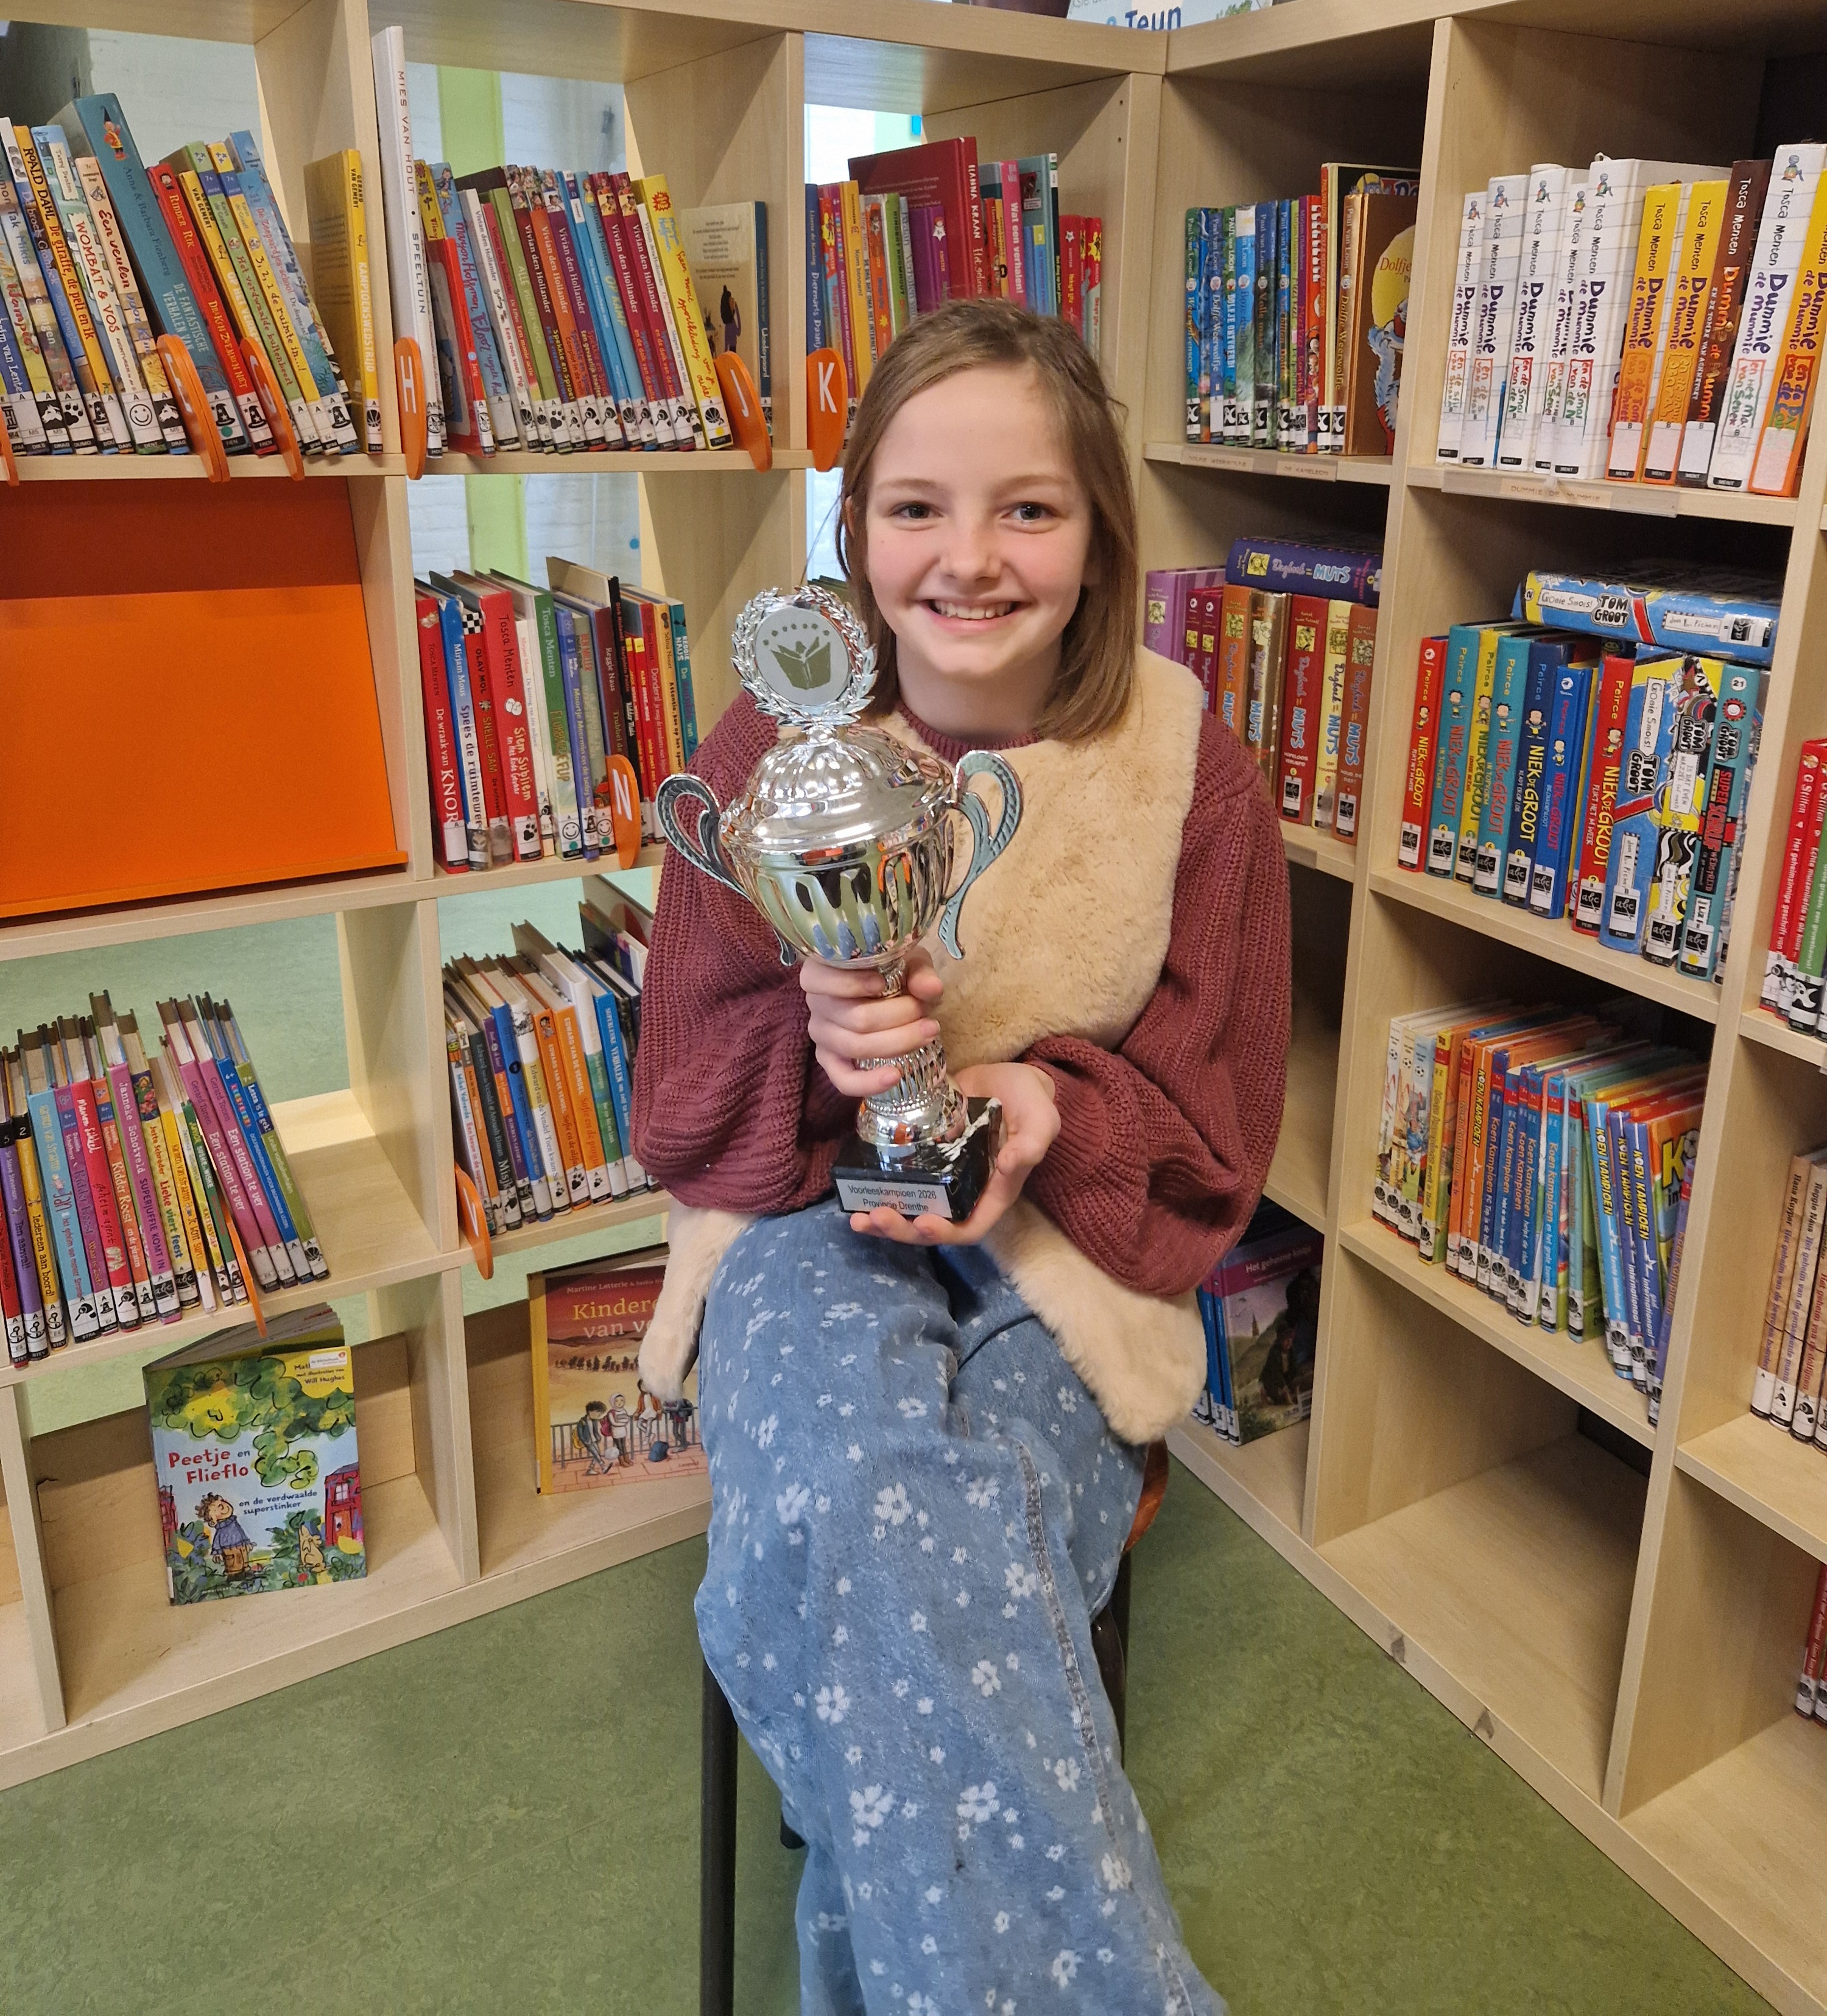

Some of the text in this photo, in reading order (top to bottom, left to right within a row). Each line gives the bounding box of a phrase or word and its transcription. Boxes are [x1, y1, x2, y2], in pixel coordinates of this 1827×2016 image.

[1125, 6, 1181, 30] Teun
[398, 71, 415, 194] MIES VAN HOUT
[23, 148, 52, 220] ROALD DAHL
[169, 194, 195, 248] RIDDER RIK
[971, 205, 980, 239] KRAAN
[1589, 202, 1606, 274] Tosca Menten
[1728, 178, 1751, 255] Tosca Menten
[1769, 188, 1794, 266] Tosca Menten
[99, 210, 130, 289] Een veulen
[412, 233, 426, 314] SPEELTUIN
[524, 225, 535, 254] Vivian
[537, 270, 551, 314] Hollander
[1013, 247, 1023, 293] verhalen!
[1380, 258, 1412, 275] Dolfje
[49, 227, 94, 340] De giraffe, de peli en ik
[76, 221, 120, 333] WOMBAT & VOS
[358, 262, 376, 373] KAMPIOENSWEDSTRIJD
[1211, 295, 1220, 318] Dolfje
[1227, 294, 1235, 368] DOLFJE ONTVOERD!
[1572, 279, 1587, 355] de mummie
[1580, 281, 1606, 354] Dummie
[1742, 272, 1767, 354] de mummie
[1753, 274, 1789, 354] Dummie
[761, 328, 770, 378] Wonderpaard
[400, 356, 416, 414] H
[818, 362, 837, 413] K
[1510, 486, 1543, 496] DUMMIE
[1272, 558, 1305, 578] Dagboek
[1312, 564, 1351, 583] MUTS
[1594, 609, 1628, 624] GROOT
[1600, 595, 1628, 609] TOM
[499, 614, 514, 687] Tosca Menten
[541, 607, 555, 678] Tosca Menten
[675, 637, 685, 661] NAUS
[454, 644, 466, 697] Mirjam Mous
[476, 647, 487, 694] OLAV MOL
[437, 708, 444, 722] De
[1612, 680, 1624, 720] Peirce
[437, 723, 448, 748] wraak
[460, 704, 474, 757] Spees de
[482, 716, 497, 773] SNELLE SAM
[1290, 707, 1306, 749] MUTS
[514, 727, 531, 801] Siem Subliem
[1627, 753, 1643, 793] GROOT
[1641, 756, 1660, 792] TOM
[1717, 771, 1733, 804] SUPER
[441, 768, 460, 823] KNOR
[613, 770, 630, 821] N
[1519, 745, 1544, 843] NIEK DE GROOT
[1593, 765, 1619, 868] NIEK DE GROOT
[1798, 785, 1813, 813] Stilton
[1616, 899, 1634, 910] abc
[564, 1017, 574, 1045] EDWARD
[576, 1069, 585, 1094] VENDEL
[19, 1127, 26, 1136] 2
[119, 1083, 145, 1175] Janneke Schotveld
[111, 1161, 131, 1223] Ridder Roest
[209, 1131, 245, 1211] Een station te ver
[848, 1185, 936, 1199] Voorleeskampioen 2026
[1524, 1138, 1536, 1217] Koen Kampioen
[1595, 1128, 1613, 1215] KOEN KAMPIOEN
[1633, 1150, 1649, 1239] KOEN KAMPIOEN
[139, 1178, 165, 1269] SUPERJUFFIE KOMT IN
[160, 1179, 182, 1259] Lieke viert feest
[863, 1199, 929, 1212] Provincie Drenthe
[1786, 1174, 1802, 1226] Hans Kuyper
[15, 1223, 31, 1270] Ten aanval!
[32, 1215, 44, 1254] Iedereen
[41, 1270, 55, 1297] boord!
[1246, 1263, 1259, 1273] Het
[567, 1280, 628, 1294] Martine Letterie
[1642, 1277, 1653, 1338] Internationaal
[583, 1322, 625, 1338] van
[320, 1374, 345, 1383] Hughes
[168, 1449, 230, 1468] Peetje
[186, 1463, 248, 1484] Flieflo
[243, 1501, 301, 1516] superstinker
[266, 1491, 317, 1503] verdwaalde
